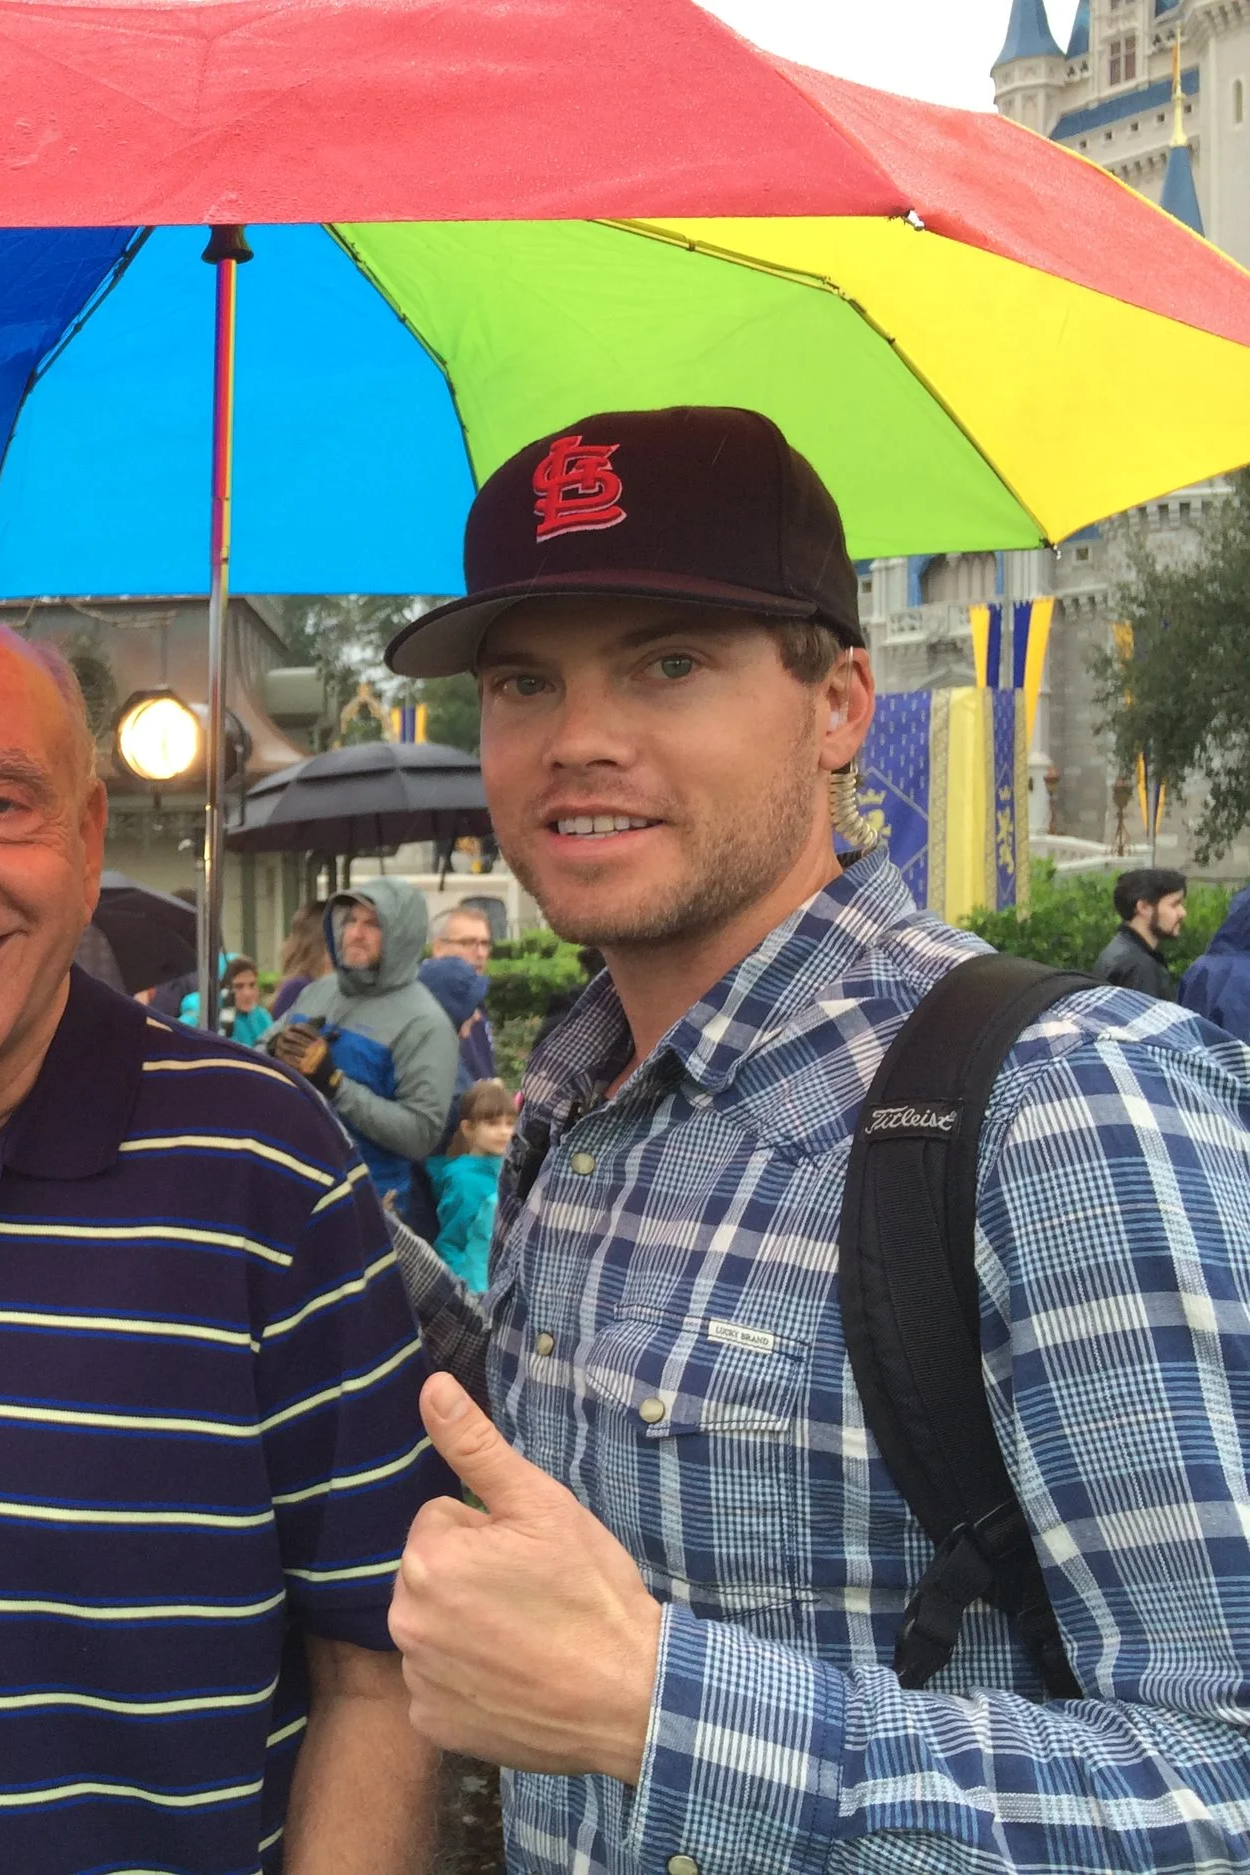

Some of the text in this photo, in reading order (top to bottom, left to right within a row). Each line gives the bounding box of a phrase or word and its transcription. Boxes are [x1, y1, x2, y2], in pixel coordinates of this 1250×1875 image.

[865, 1105, 955, 1134] Titleist
[715, 1326, 769, 1346] LUCKY BRAND
